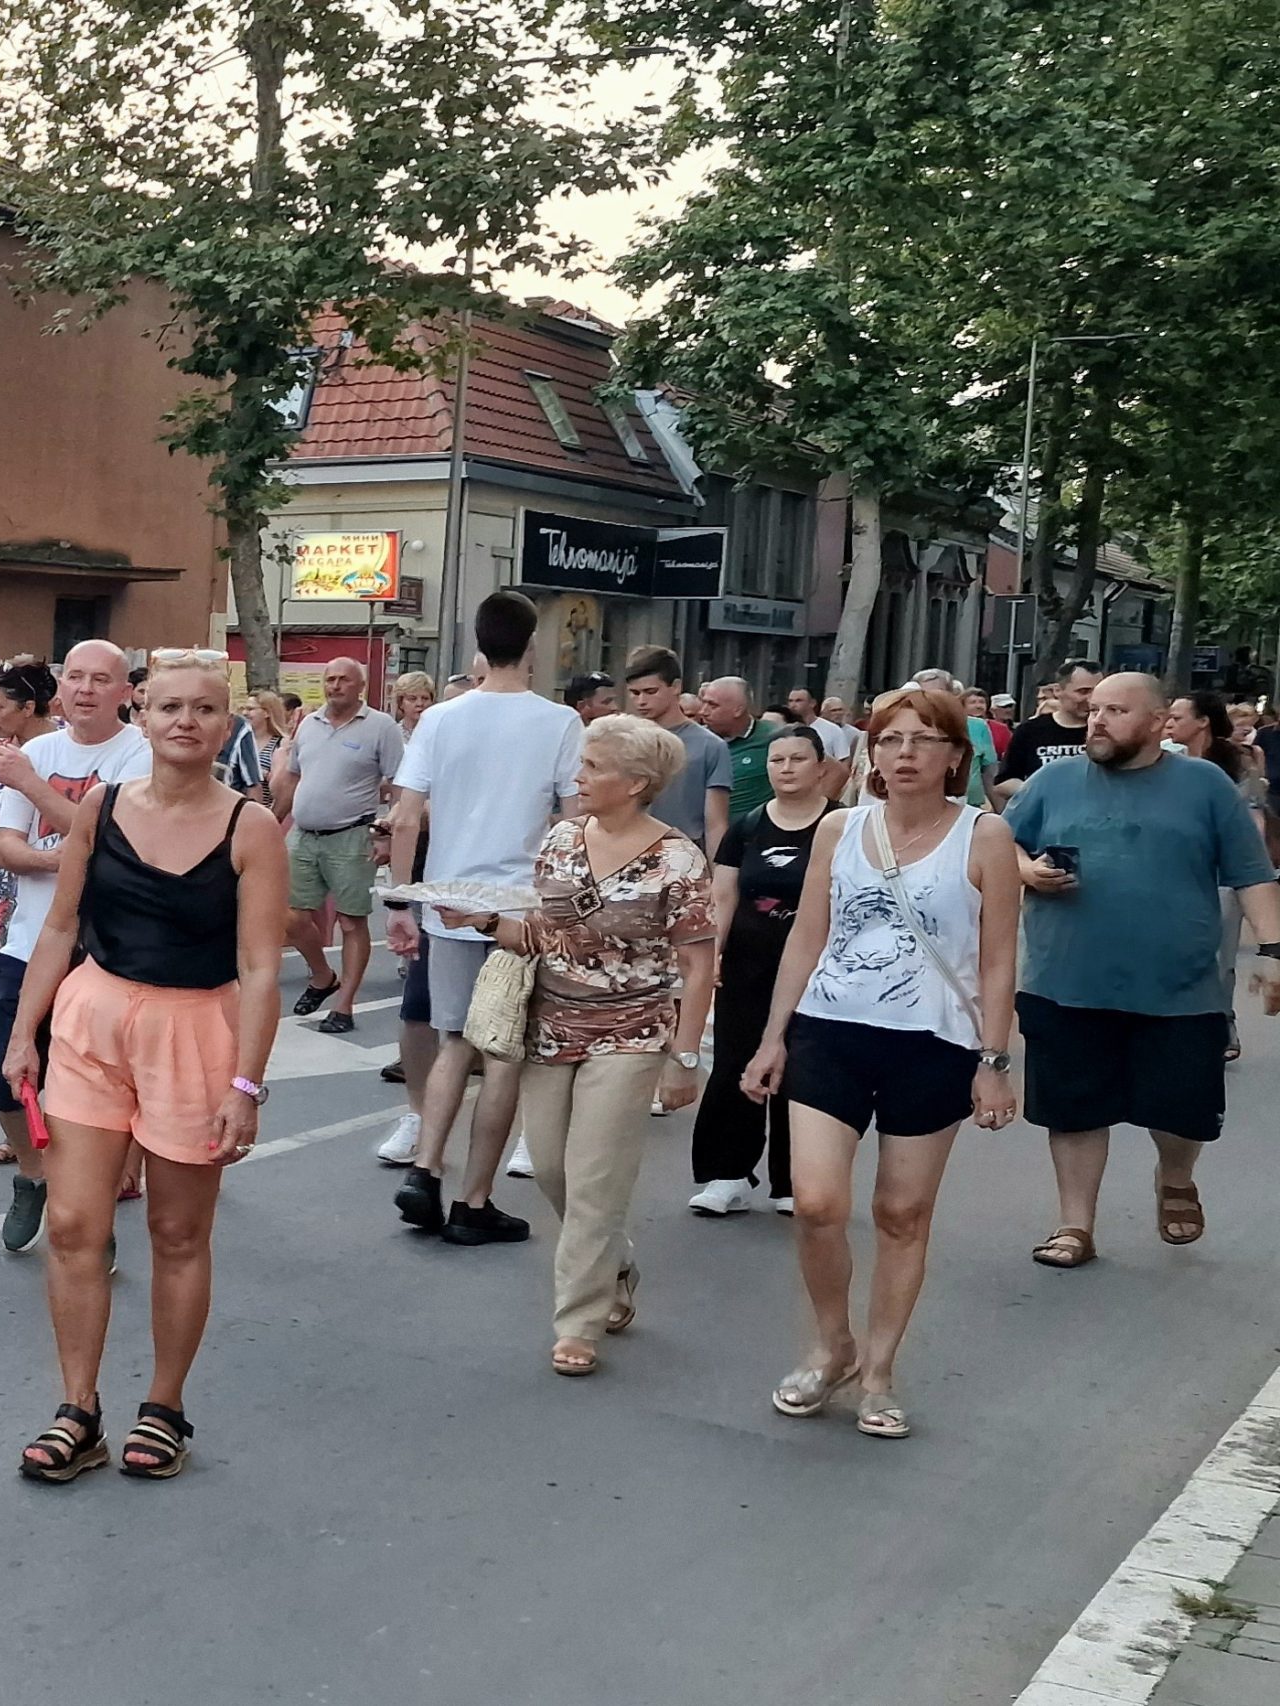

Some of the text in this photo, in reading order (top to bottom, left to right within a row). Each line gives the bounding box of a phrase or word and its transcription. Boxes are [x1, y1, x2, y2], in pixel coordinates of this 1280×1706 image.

[295, 544, 378, 555] МАРКЕТ
[539, 527, 639, 584] Tehnomanija
[1036, 744, 1088, 755] CRITIC
